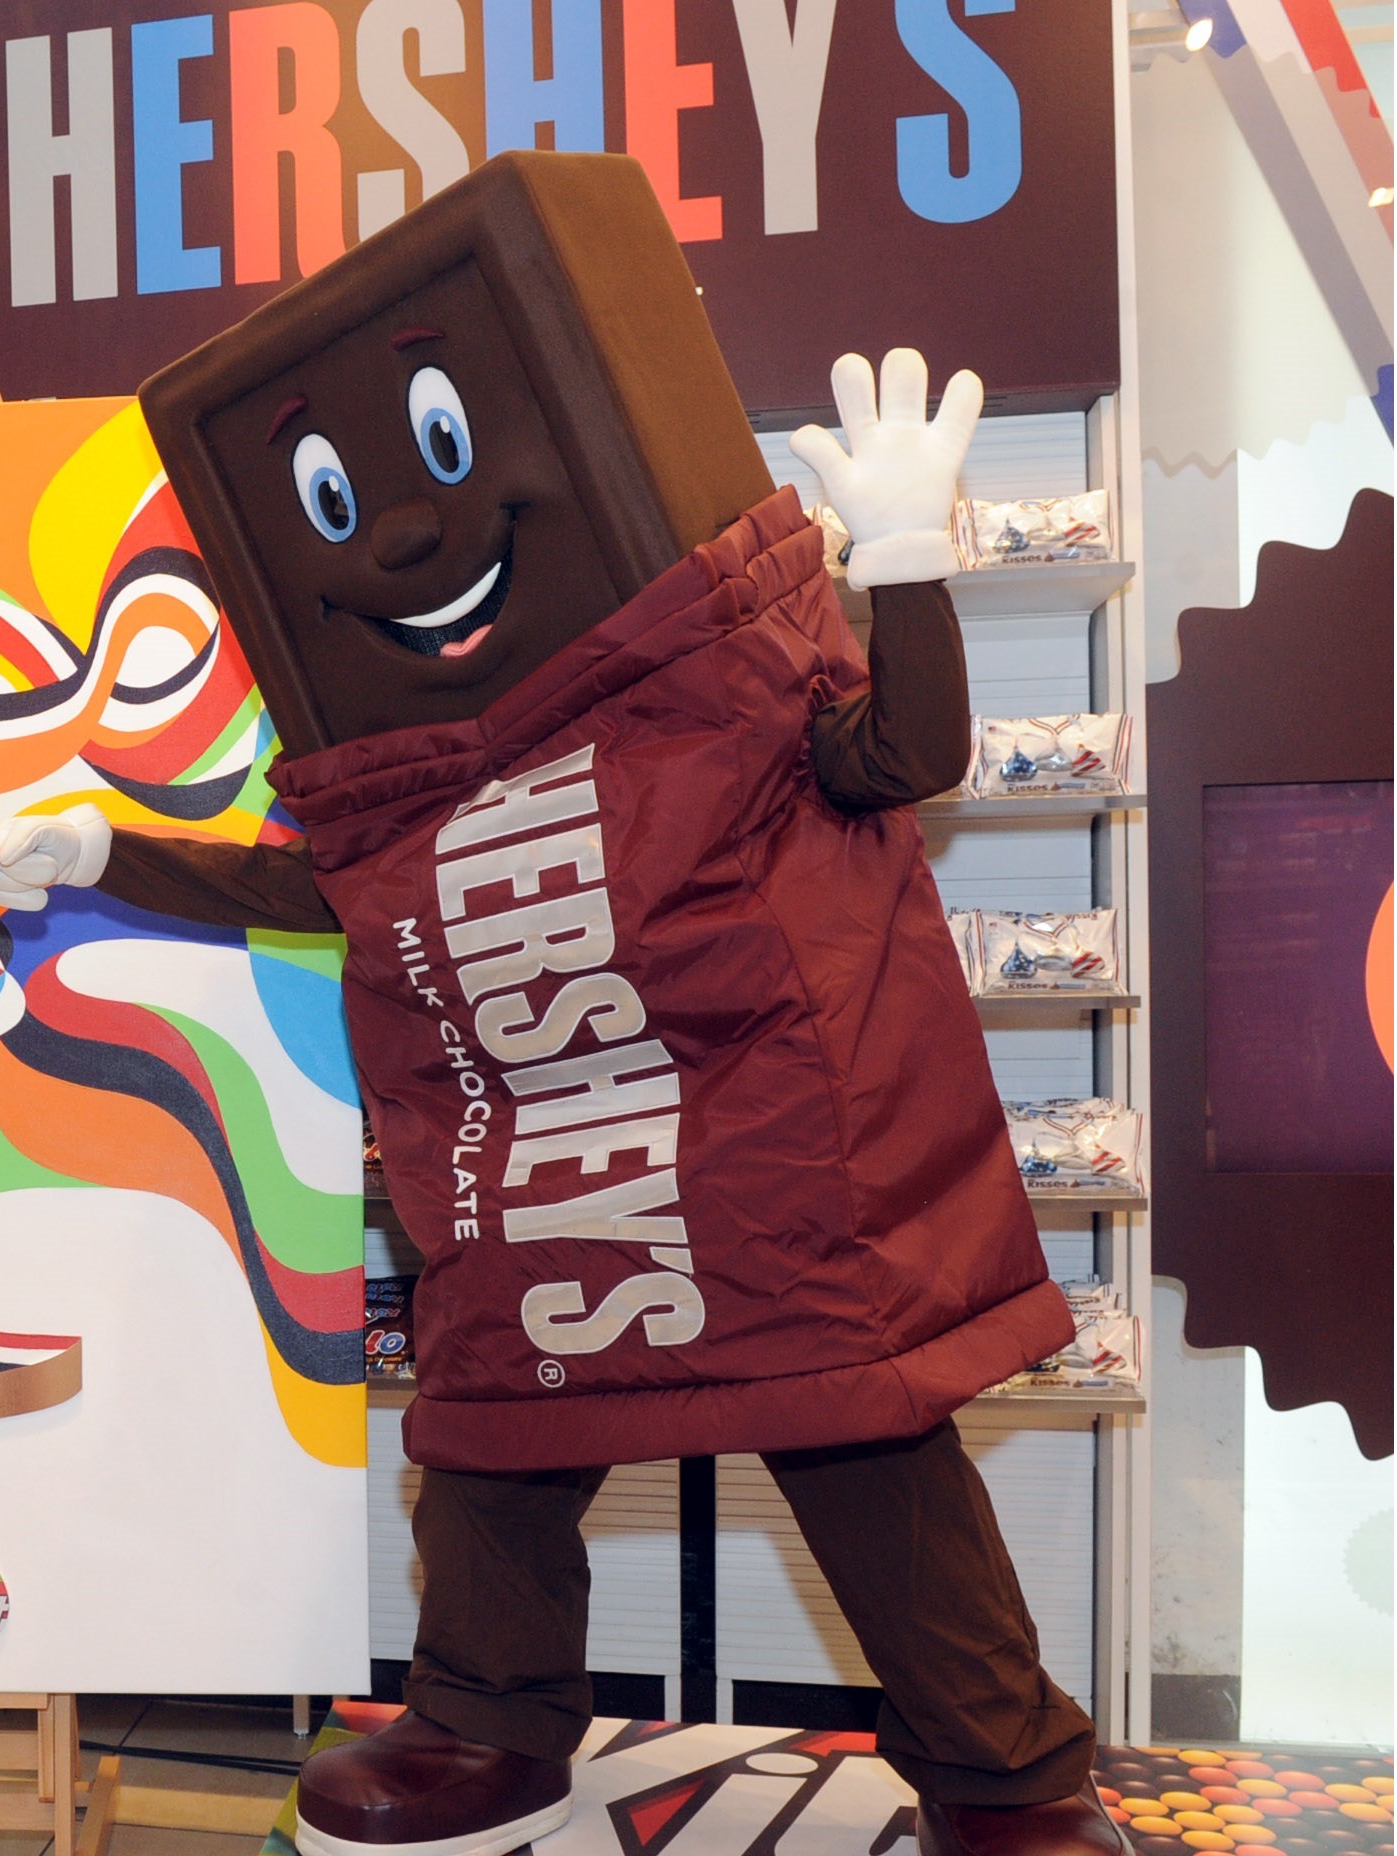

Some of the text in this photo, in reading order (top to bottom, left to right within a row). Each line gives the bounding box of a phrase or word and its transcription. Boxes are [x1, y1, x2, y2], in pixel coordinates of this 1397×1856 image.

[393, 917, 492, 1241] MILK CHOCOLATE
[435, 743, 705, 1355] HERSHEY'S
